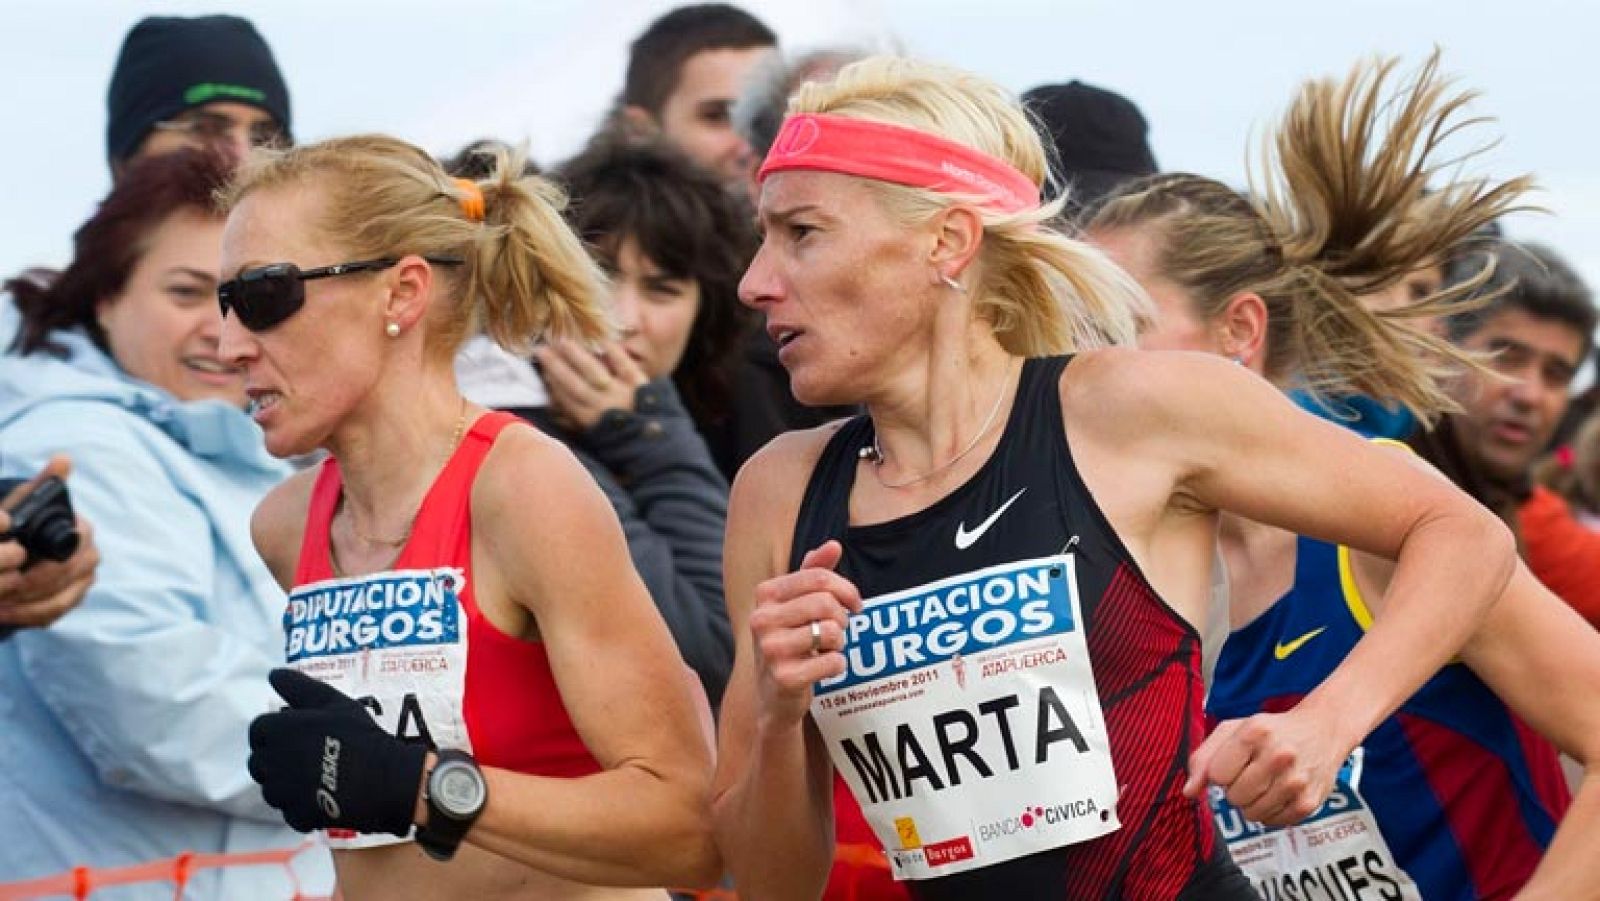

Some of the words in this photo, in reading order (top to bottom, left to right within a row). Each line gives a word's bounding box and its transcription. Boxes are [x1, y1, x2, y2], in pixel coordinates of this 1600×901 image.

[292, 580, 445, 625] DIPUTACION
[843, 568, 1049, 645] PUTACION
[289, 610, 444, 656] BURGOS
[848, 679, 908, 703] Noviembre
[911, 669, 938, 685] 2011
[840, 686, 1090, 803] MARTA
